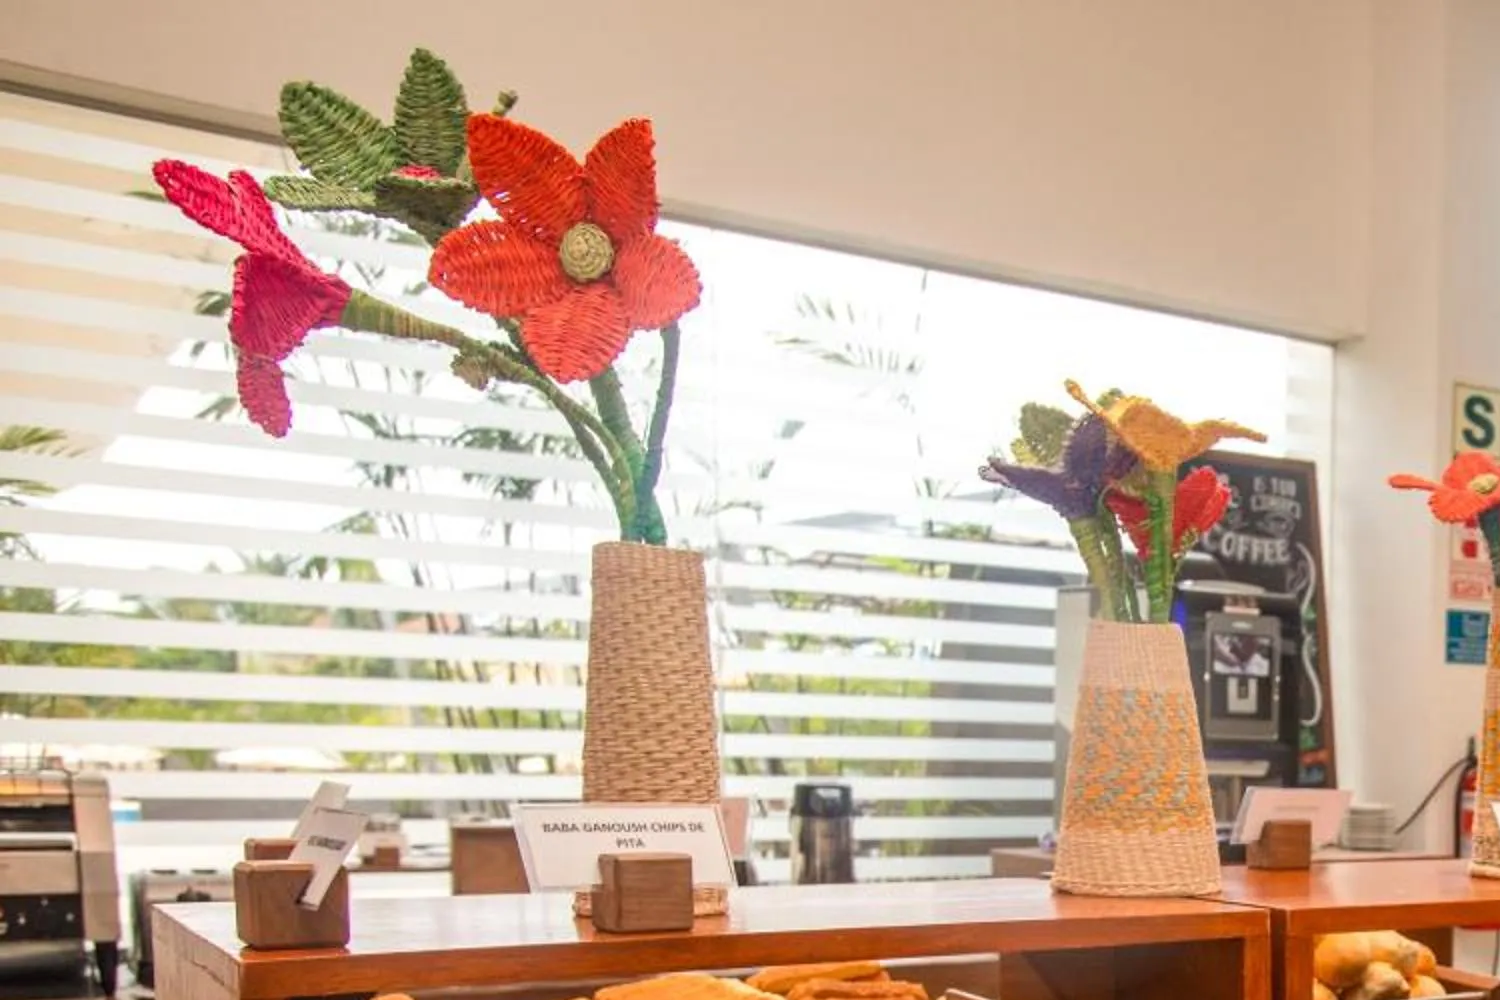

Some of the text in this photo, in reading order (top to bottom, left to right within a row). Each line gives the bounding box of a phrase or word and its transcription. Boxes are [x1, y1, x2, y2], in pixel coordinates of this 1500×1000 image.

[1462, 395, 1495, 449] S
[1203, 528, 1292, 564] COFFEE
[542, 821, 706, 833] BABA GANOUSH CHIPS DE
[616, 837, 646, 849] PITA
